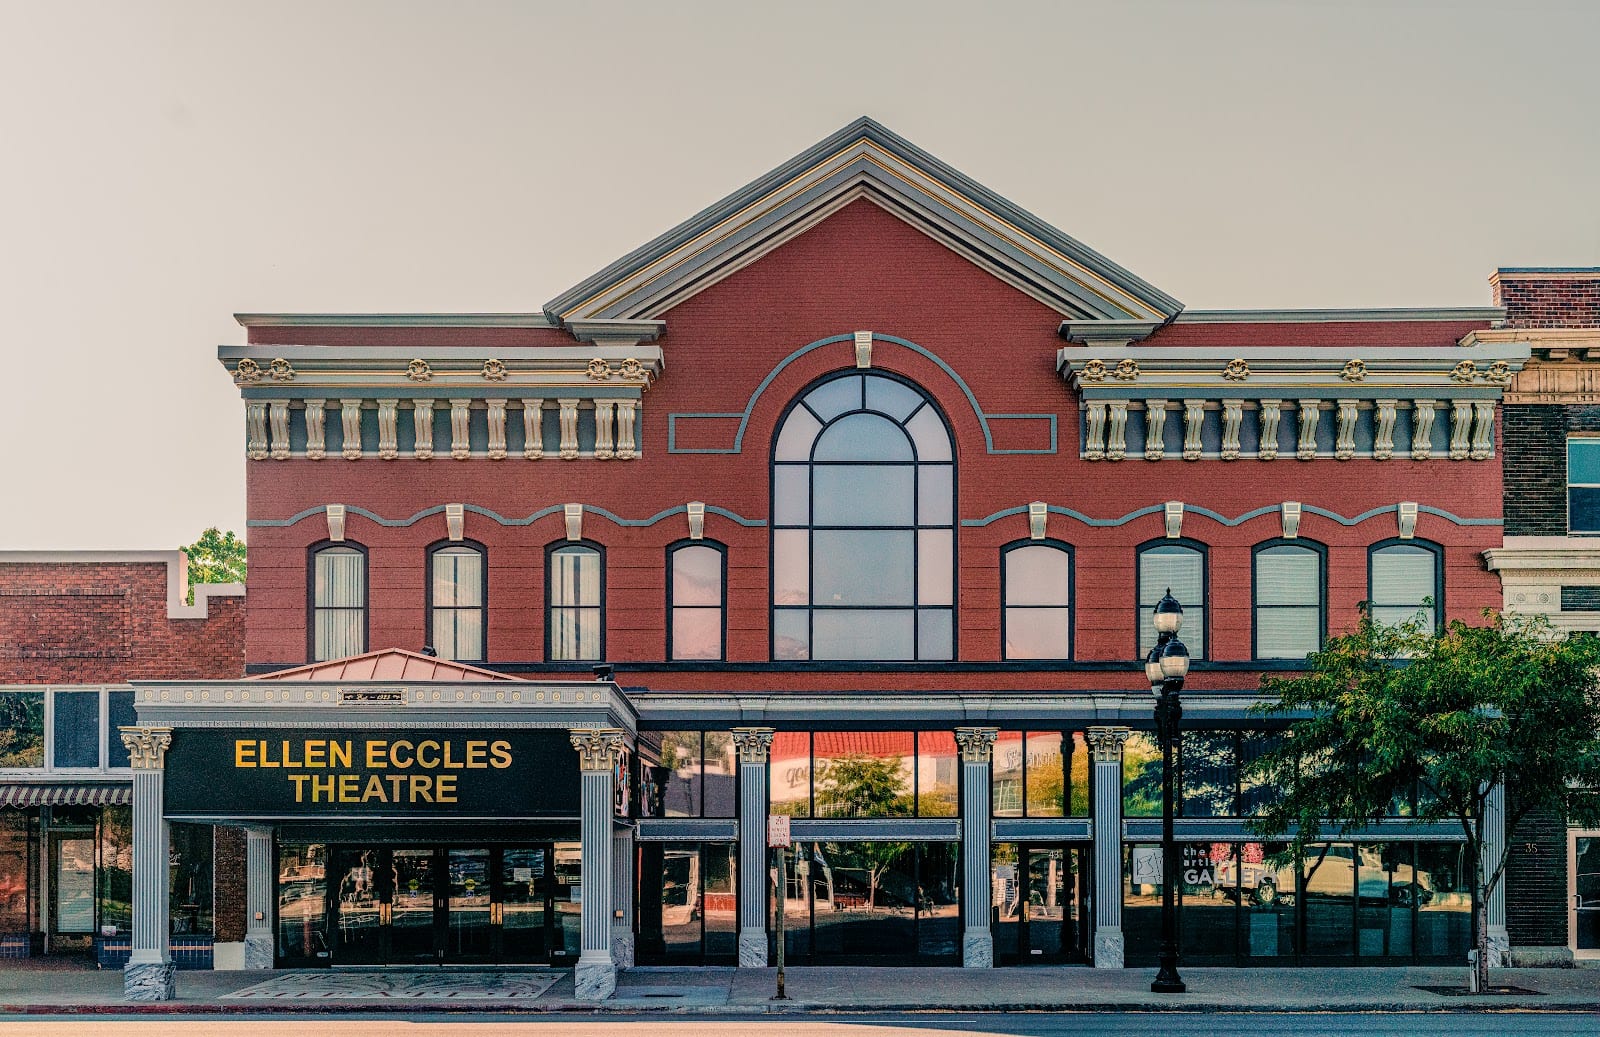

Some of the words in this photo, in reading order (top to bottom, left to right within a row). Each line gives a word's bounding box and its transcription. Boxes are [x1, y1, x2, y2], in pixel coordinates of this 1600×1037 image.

[235, 740, 352, 768] ELLEN
[366, 740, 513, 769] ECCLES
[288, 775, 458, 803] THEATRE
[1183, 847, 1206, 856] the
[1525, 842, 1538, 854] 35
[1049, 850, 1059, 859] 43
